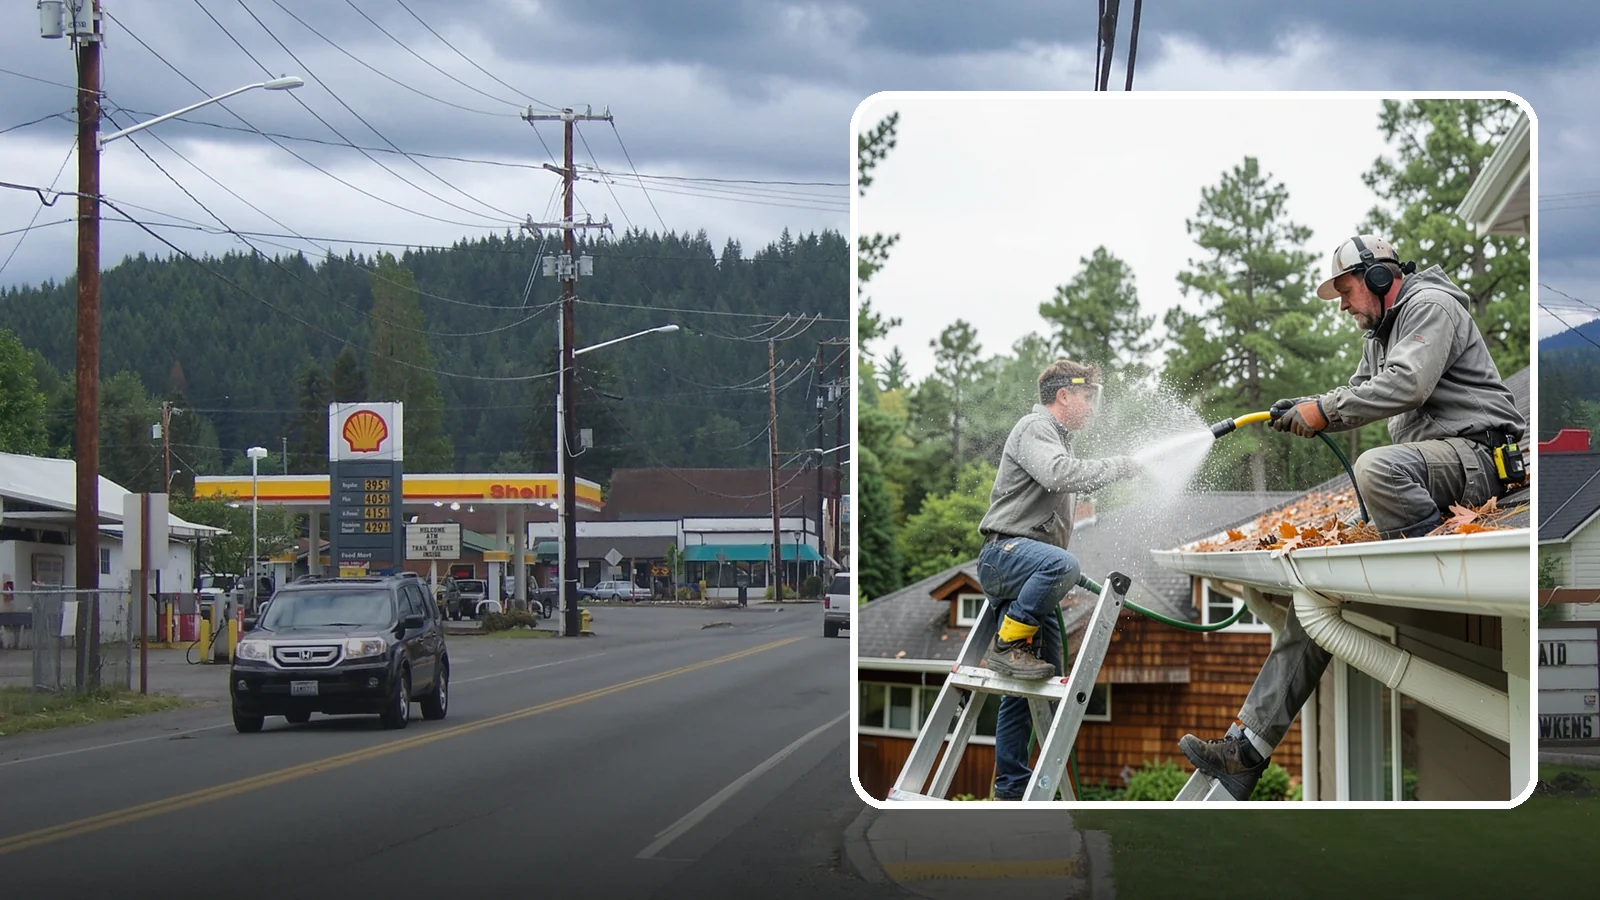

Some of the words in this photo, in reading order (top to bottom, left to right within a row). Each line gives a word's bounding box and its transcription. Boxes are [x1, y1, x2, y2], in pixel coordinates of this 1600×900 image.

[366, 480, 384, 490] 395
[490, 484, 547, 499] Shell
[366, 494, 383, 504] 405
[366, 508, 383, 518] 415
[366, 522, 383, 533] 429
